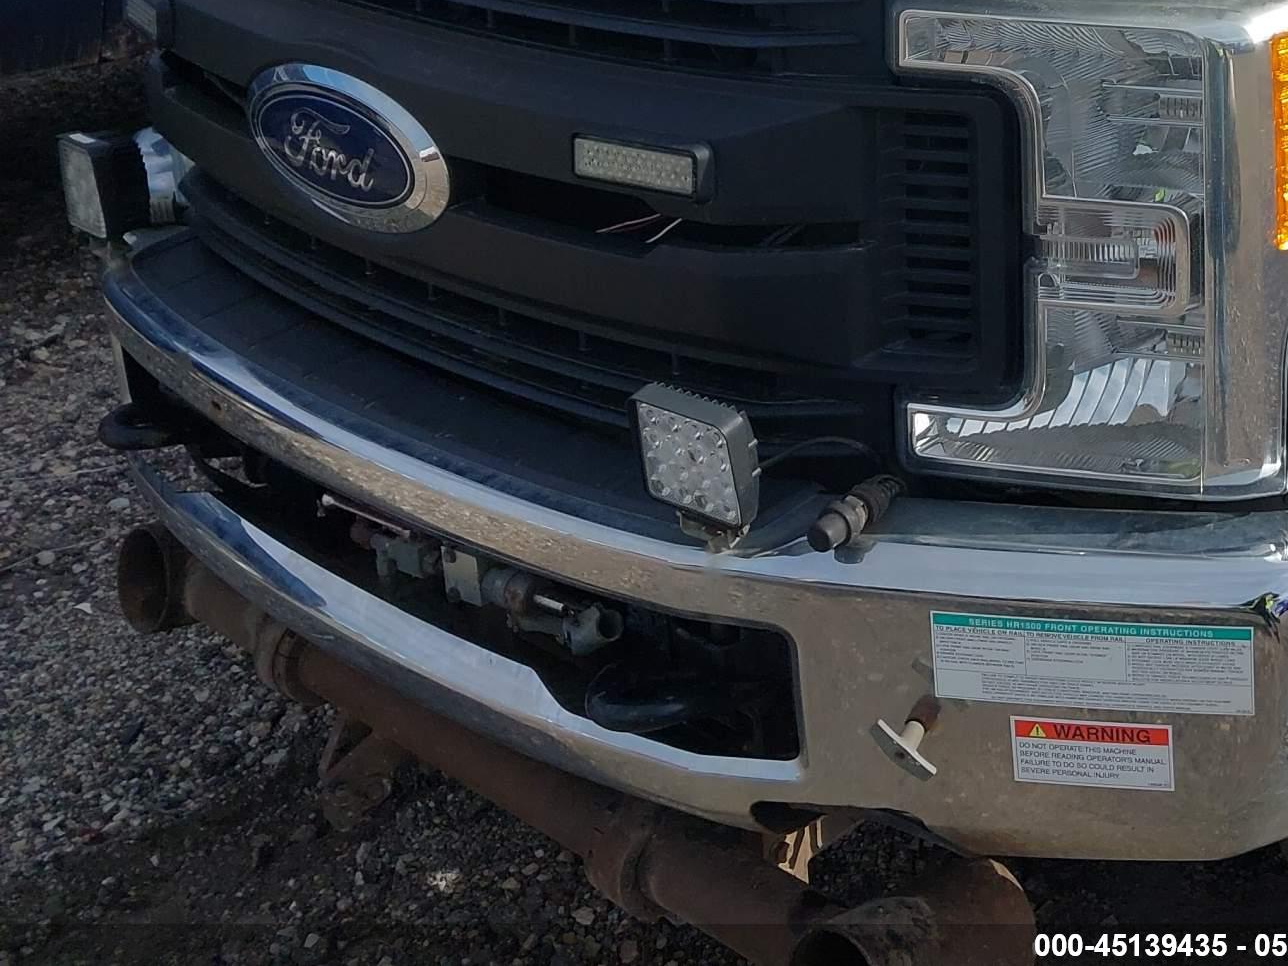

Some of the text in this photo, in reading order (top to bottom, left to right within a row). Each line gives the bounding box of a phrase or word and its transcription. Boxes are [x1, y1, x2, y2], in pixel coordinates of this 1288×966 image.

[284, 106, 375, 192] Ford
[968, 617, 1004, 628] SERIES
[1045, 621, 1078, 632] FRONT
[1081, 623, 1137, 635] OPERATING
[1140, 626, 1214, 638] INSTRUCTIONS
[1053, 724, 1150, 743] WARNING
[1019, 750, 1049, 758] BEFORE
[1051, 752, 1085, 761] READING
[1049, 744, 1083, 753] OPERATE
[1085, 746, 1101, 754] THIS
[1103, 747, 1137, 756] MACHINE
[1020, 759, 1049, 767] FAILURE
[1052, 760, 1062, 768] TO
[1089, 763, 1115, 771] COULD
[1116, 764, 1145, 773] RESULT
[1021, 767, 1050, 775] SEVERE
[1052, 769, 1092, 778] PERSONAL
